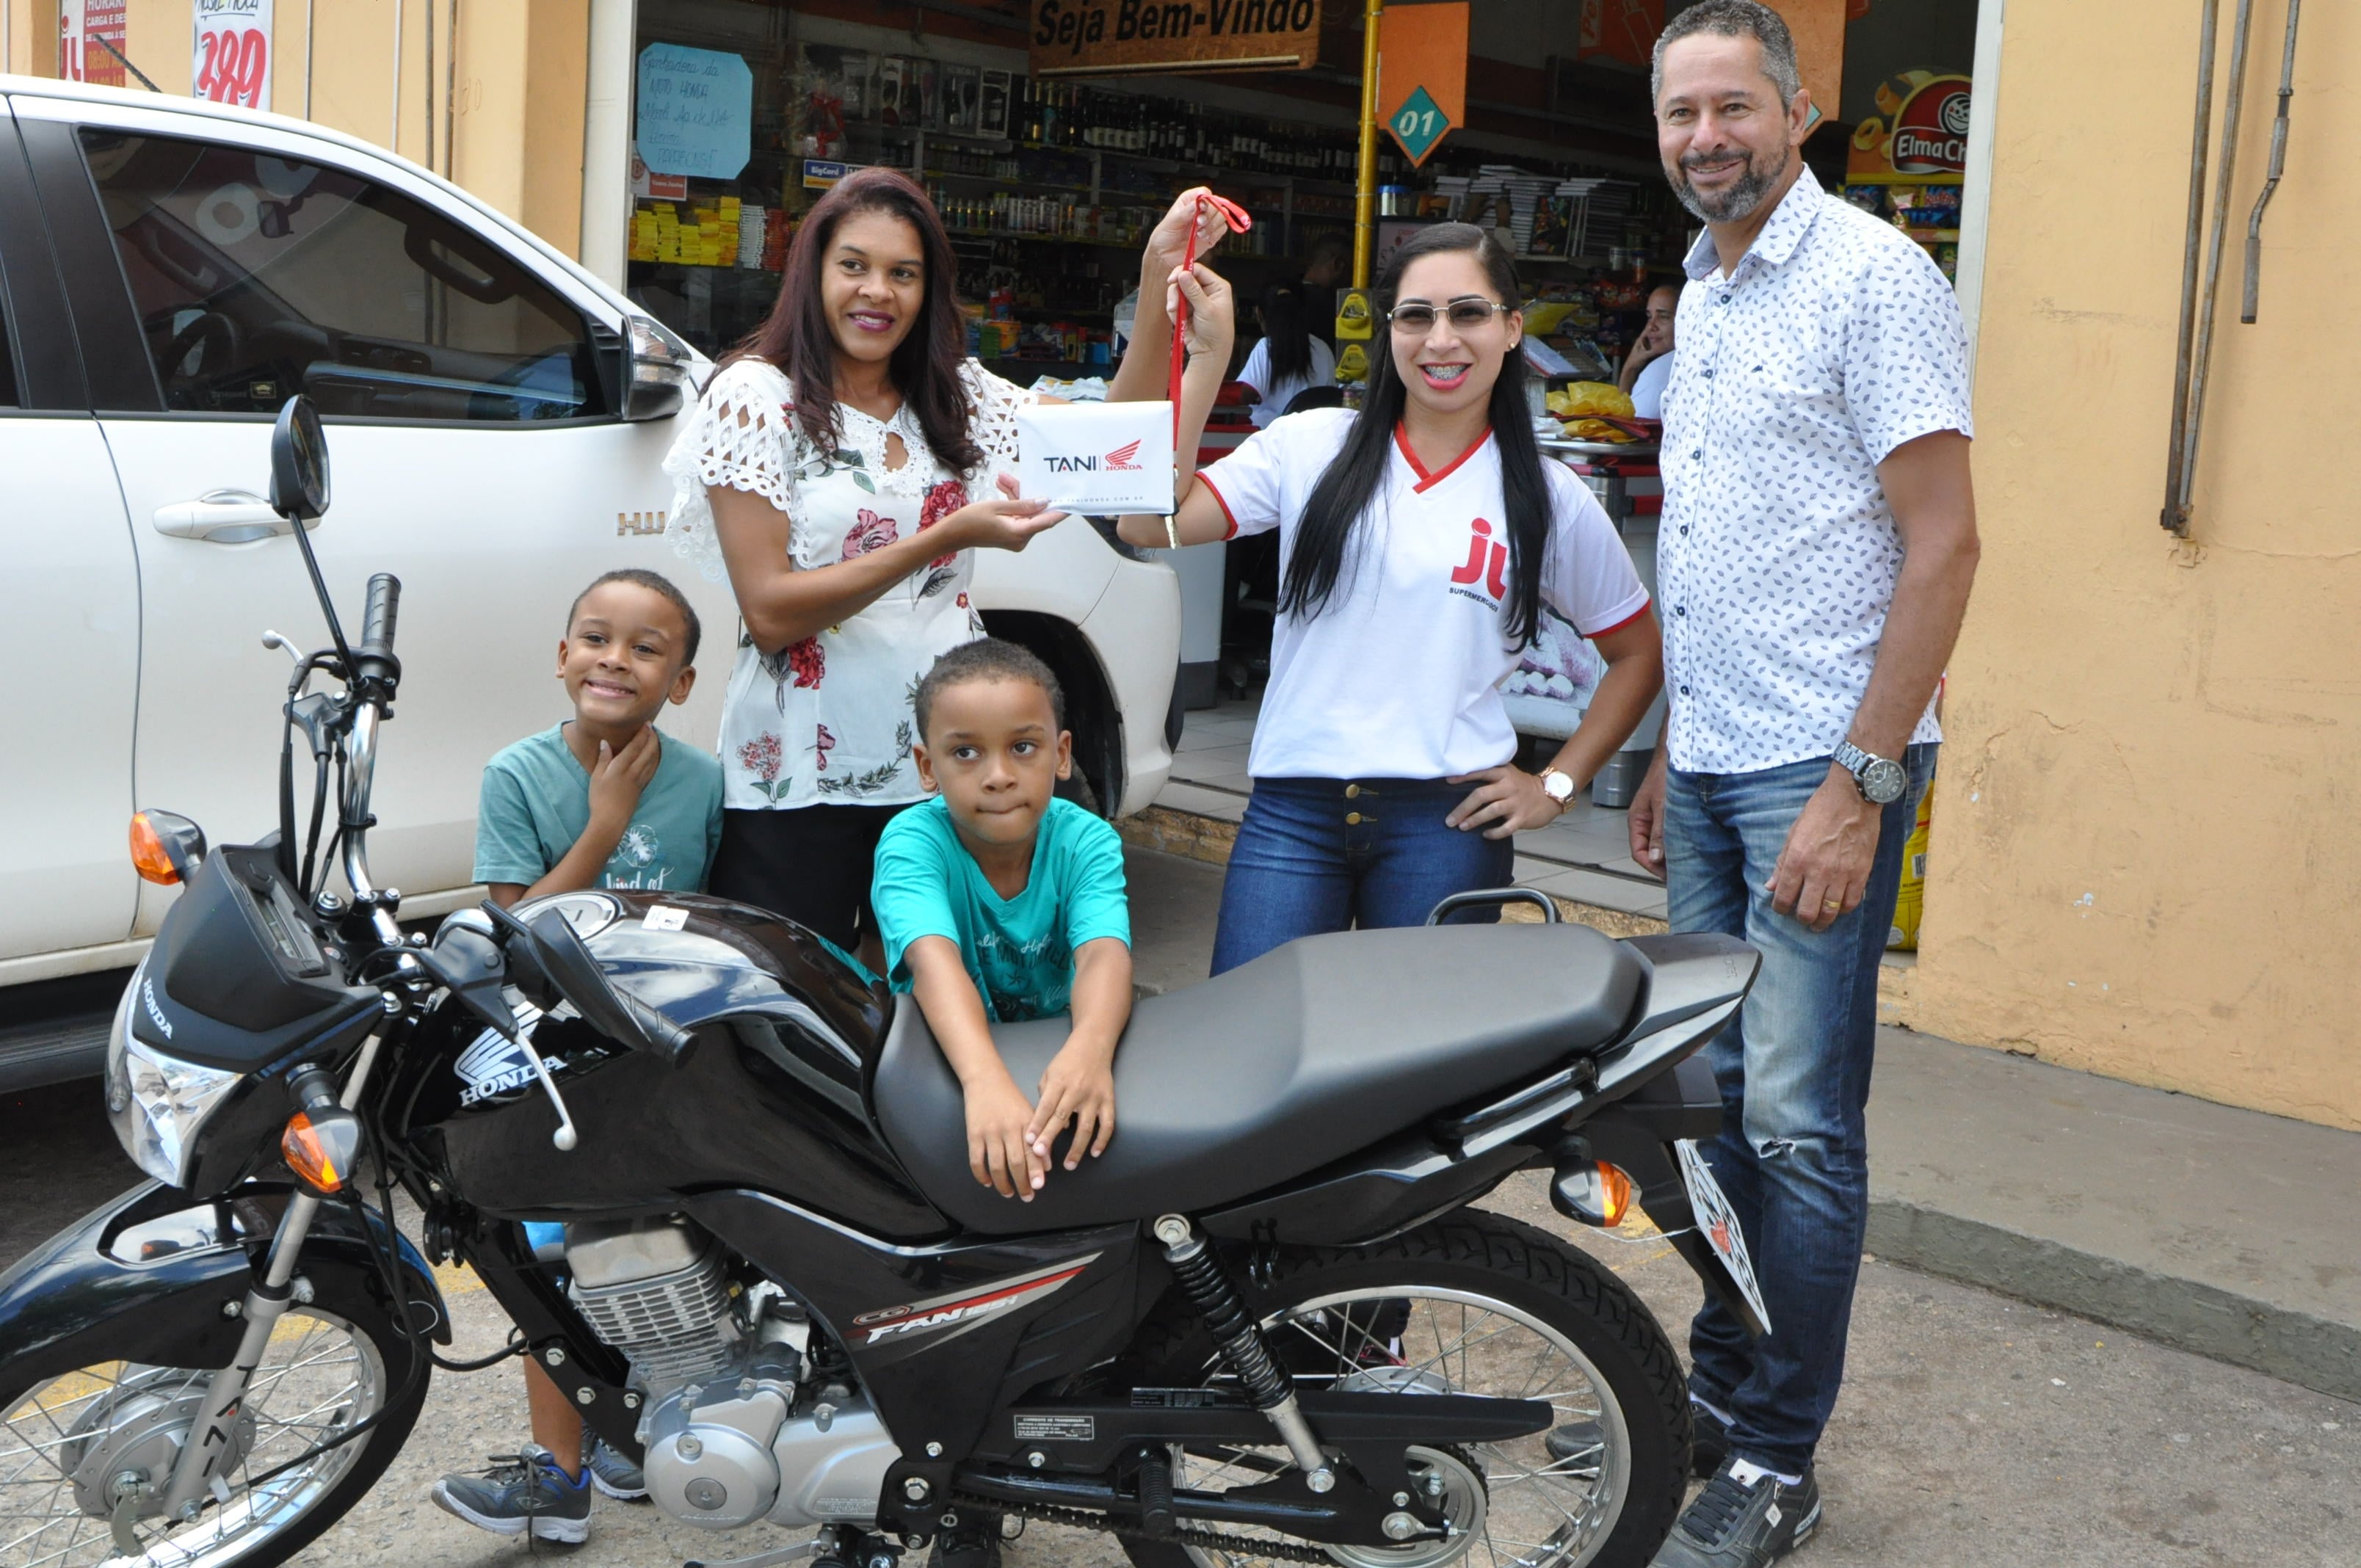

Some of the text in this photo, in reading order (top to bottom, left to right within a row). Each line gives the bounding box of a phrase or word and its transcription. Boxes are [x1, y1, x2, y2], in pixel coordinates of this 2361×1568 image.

[1036, 0, 1104, 55] Seja
[1399, 110, 1435, 137] 01
[1043, 455, 1097, 473] TANI
[143, 977, 173, 1040] HONDA
[866, 1307, 966, 1346] FAN
